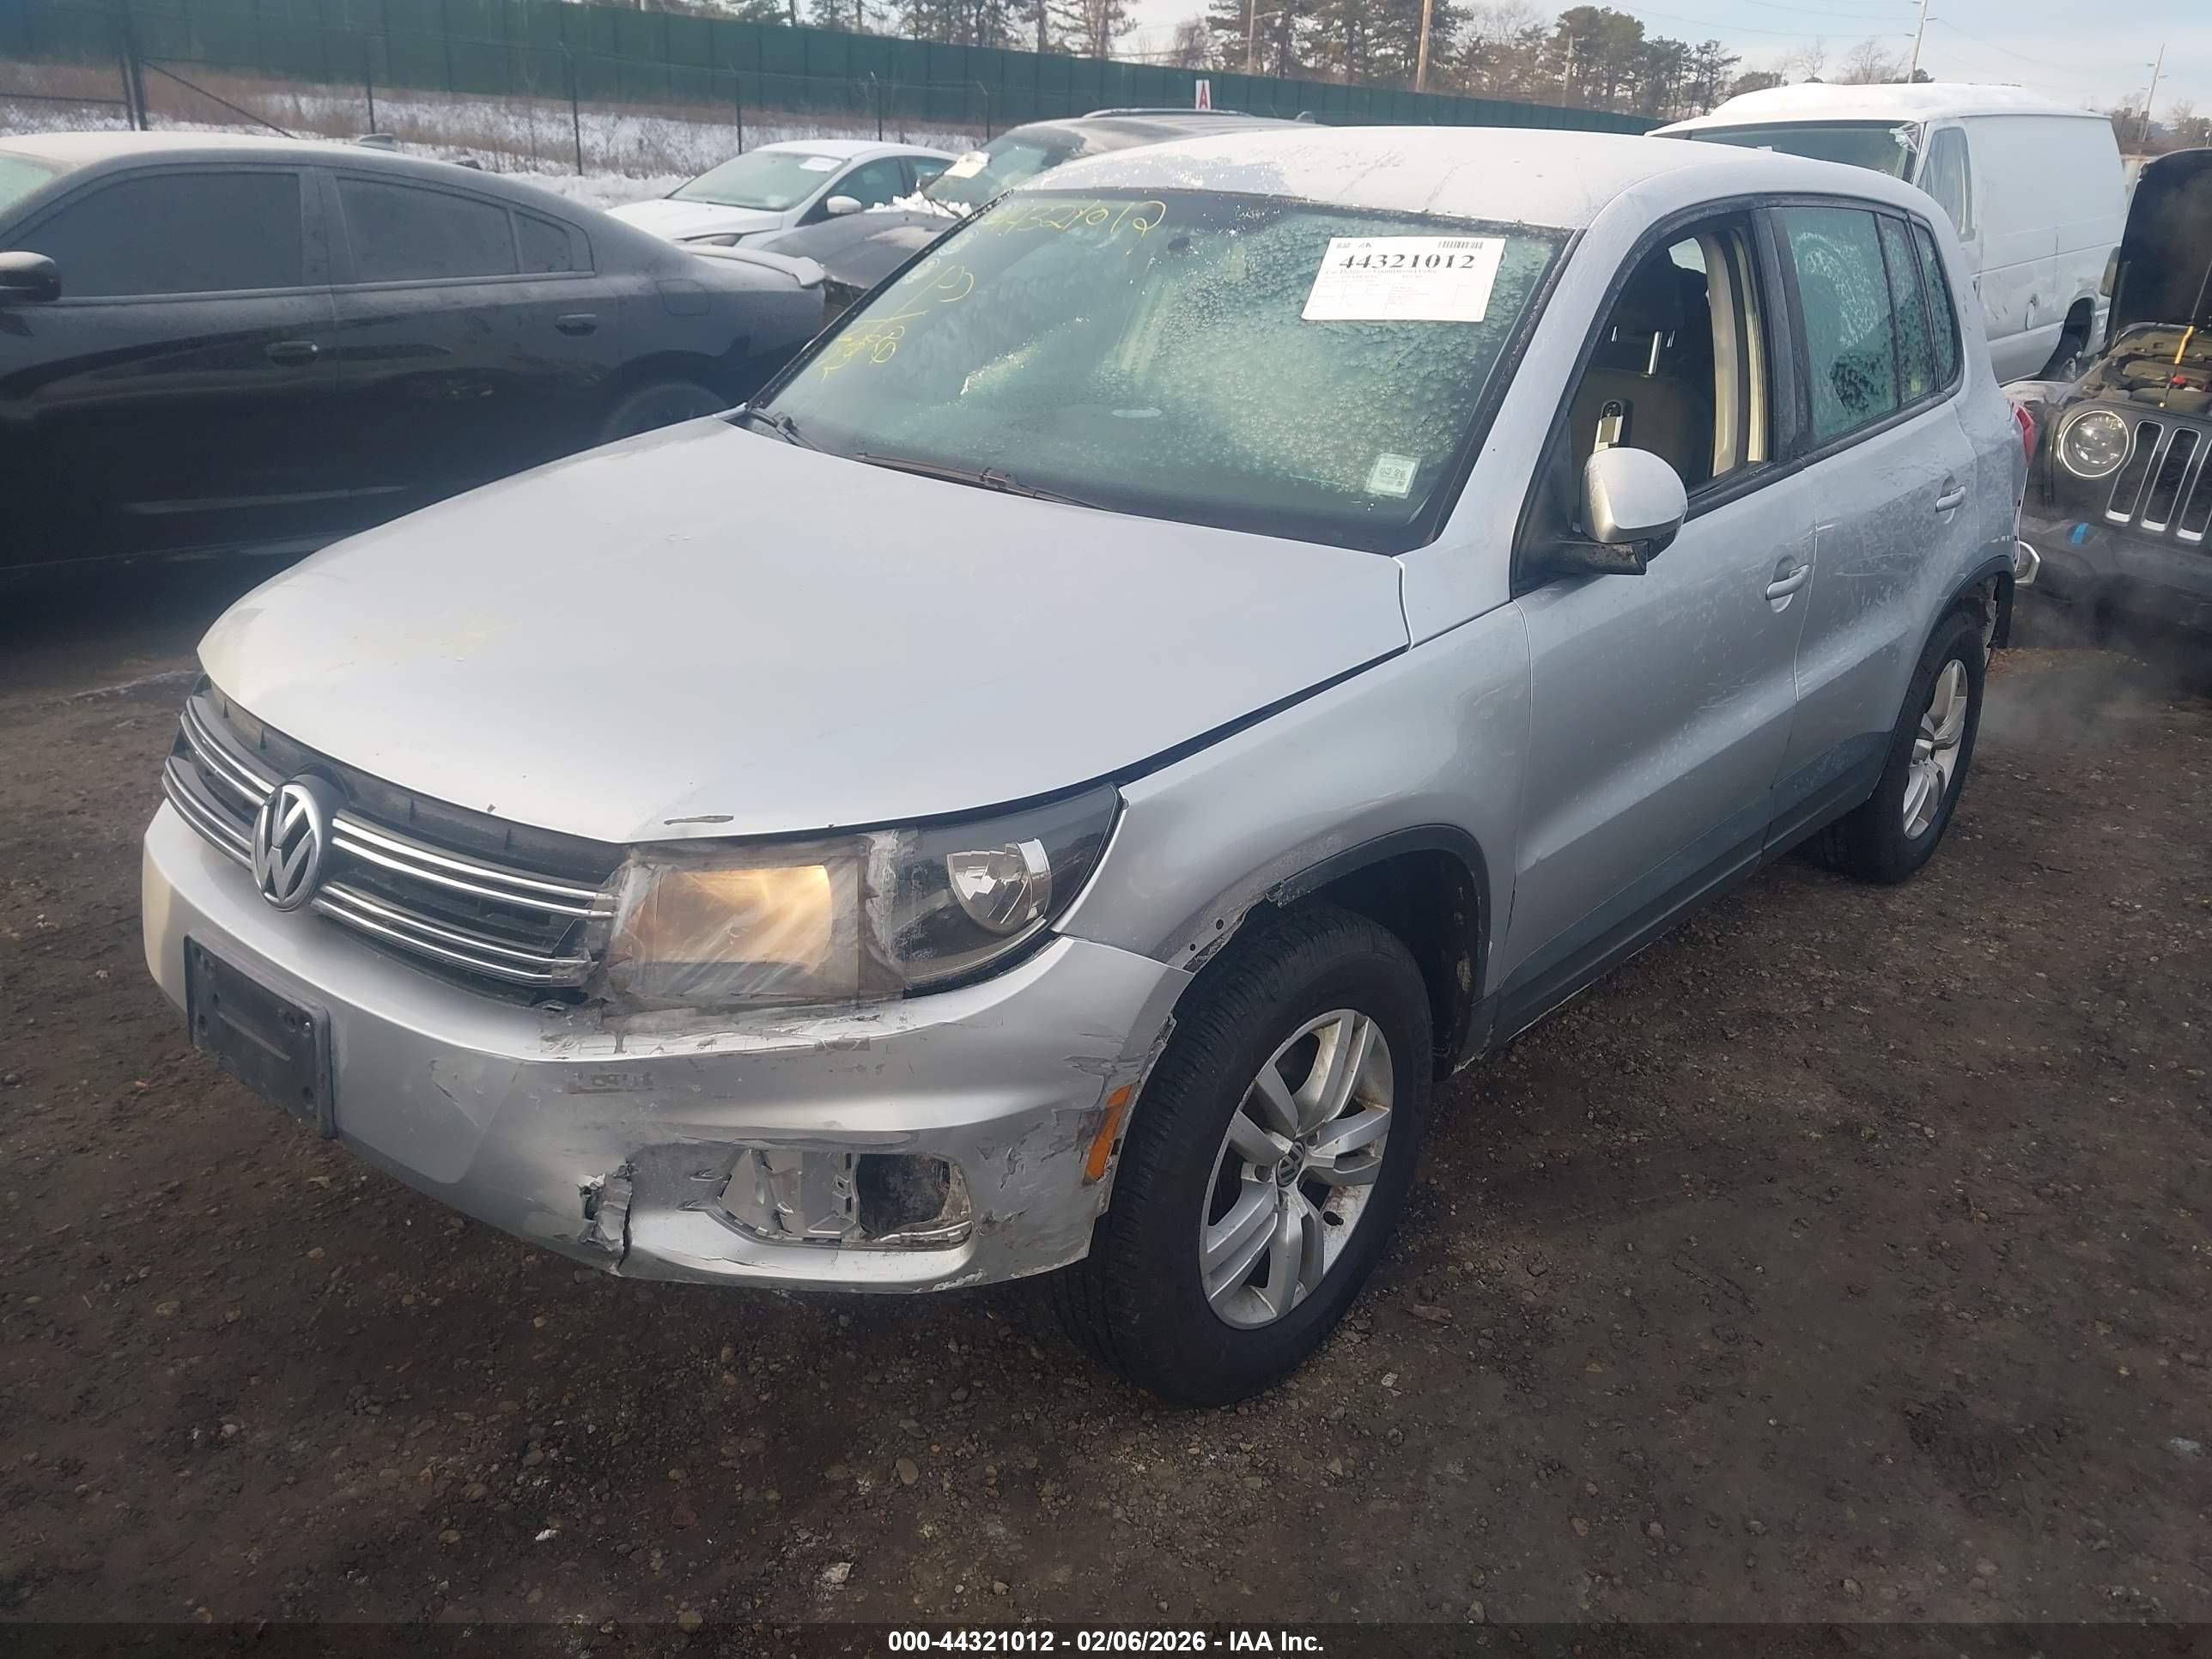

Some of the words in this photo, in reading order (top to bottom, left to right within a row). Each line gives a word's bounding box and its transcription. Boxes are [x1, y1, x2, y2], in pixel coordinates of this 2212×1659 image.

[1199, 81, 1208, 109] A
[1339, 254, 1475, 268] 44321012
[255, 782, 322, 911] VW
